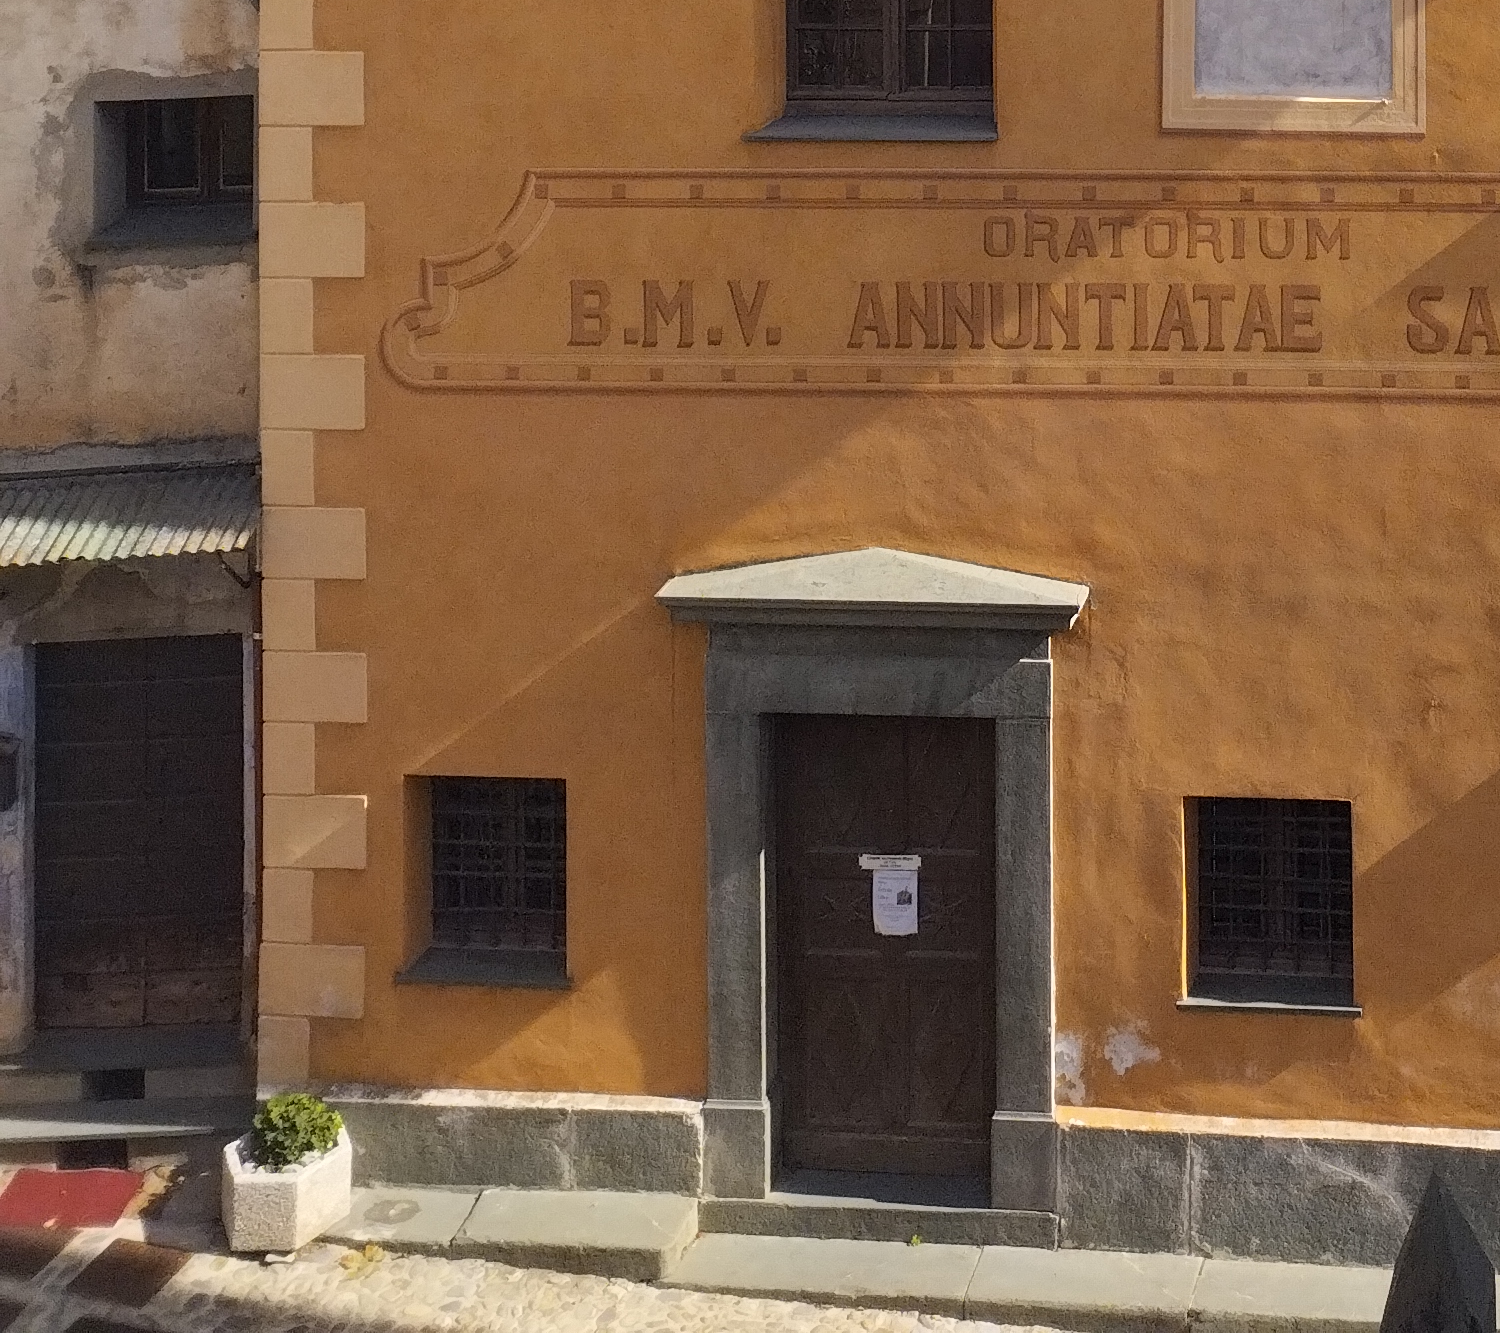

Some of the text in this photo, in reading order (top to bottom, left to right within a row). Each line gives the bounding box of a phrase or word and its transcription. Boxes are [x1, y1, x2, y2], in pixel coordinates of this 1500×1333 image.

[983, 209, 1350, 264] ORATORIUM
[566, 279, 782, 349] B.M.V.
[846, 280, 1322, 353] ANNUNTIATAE
